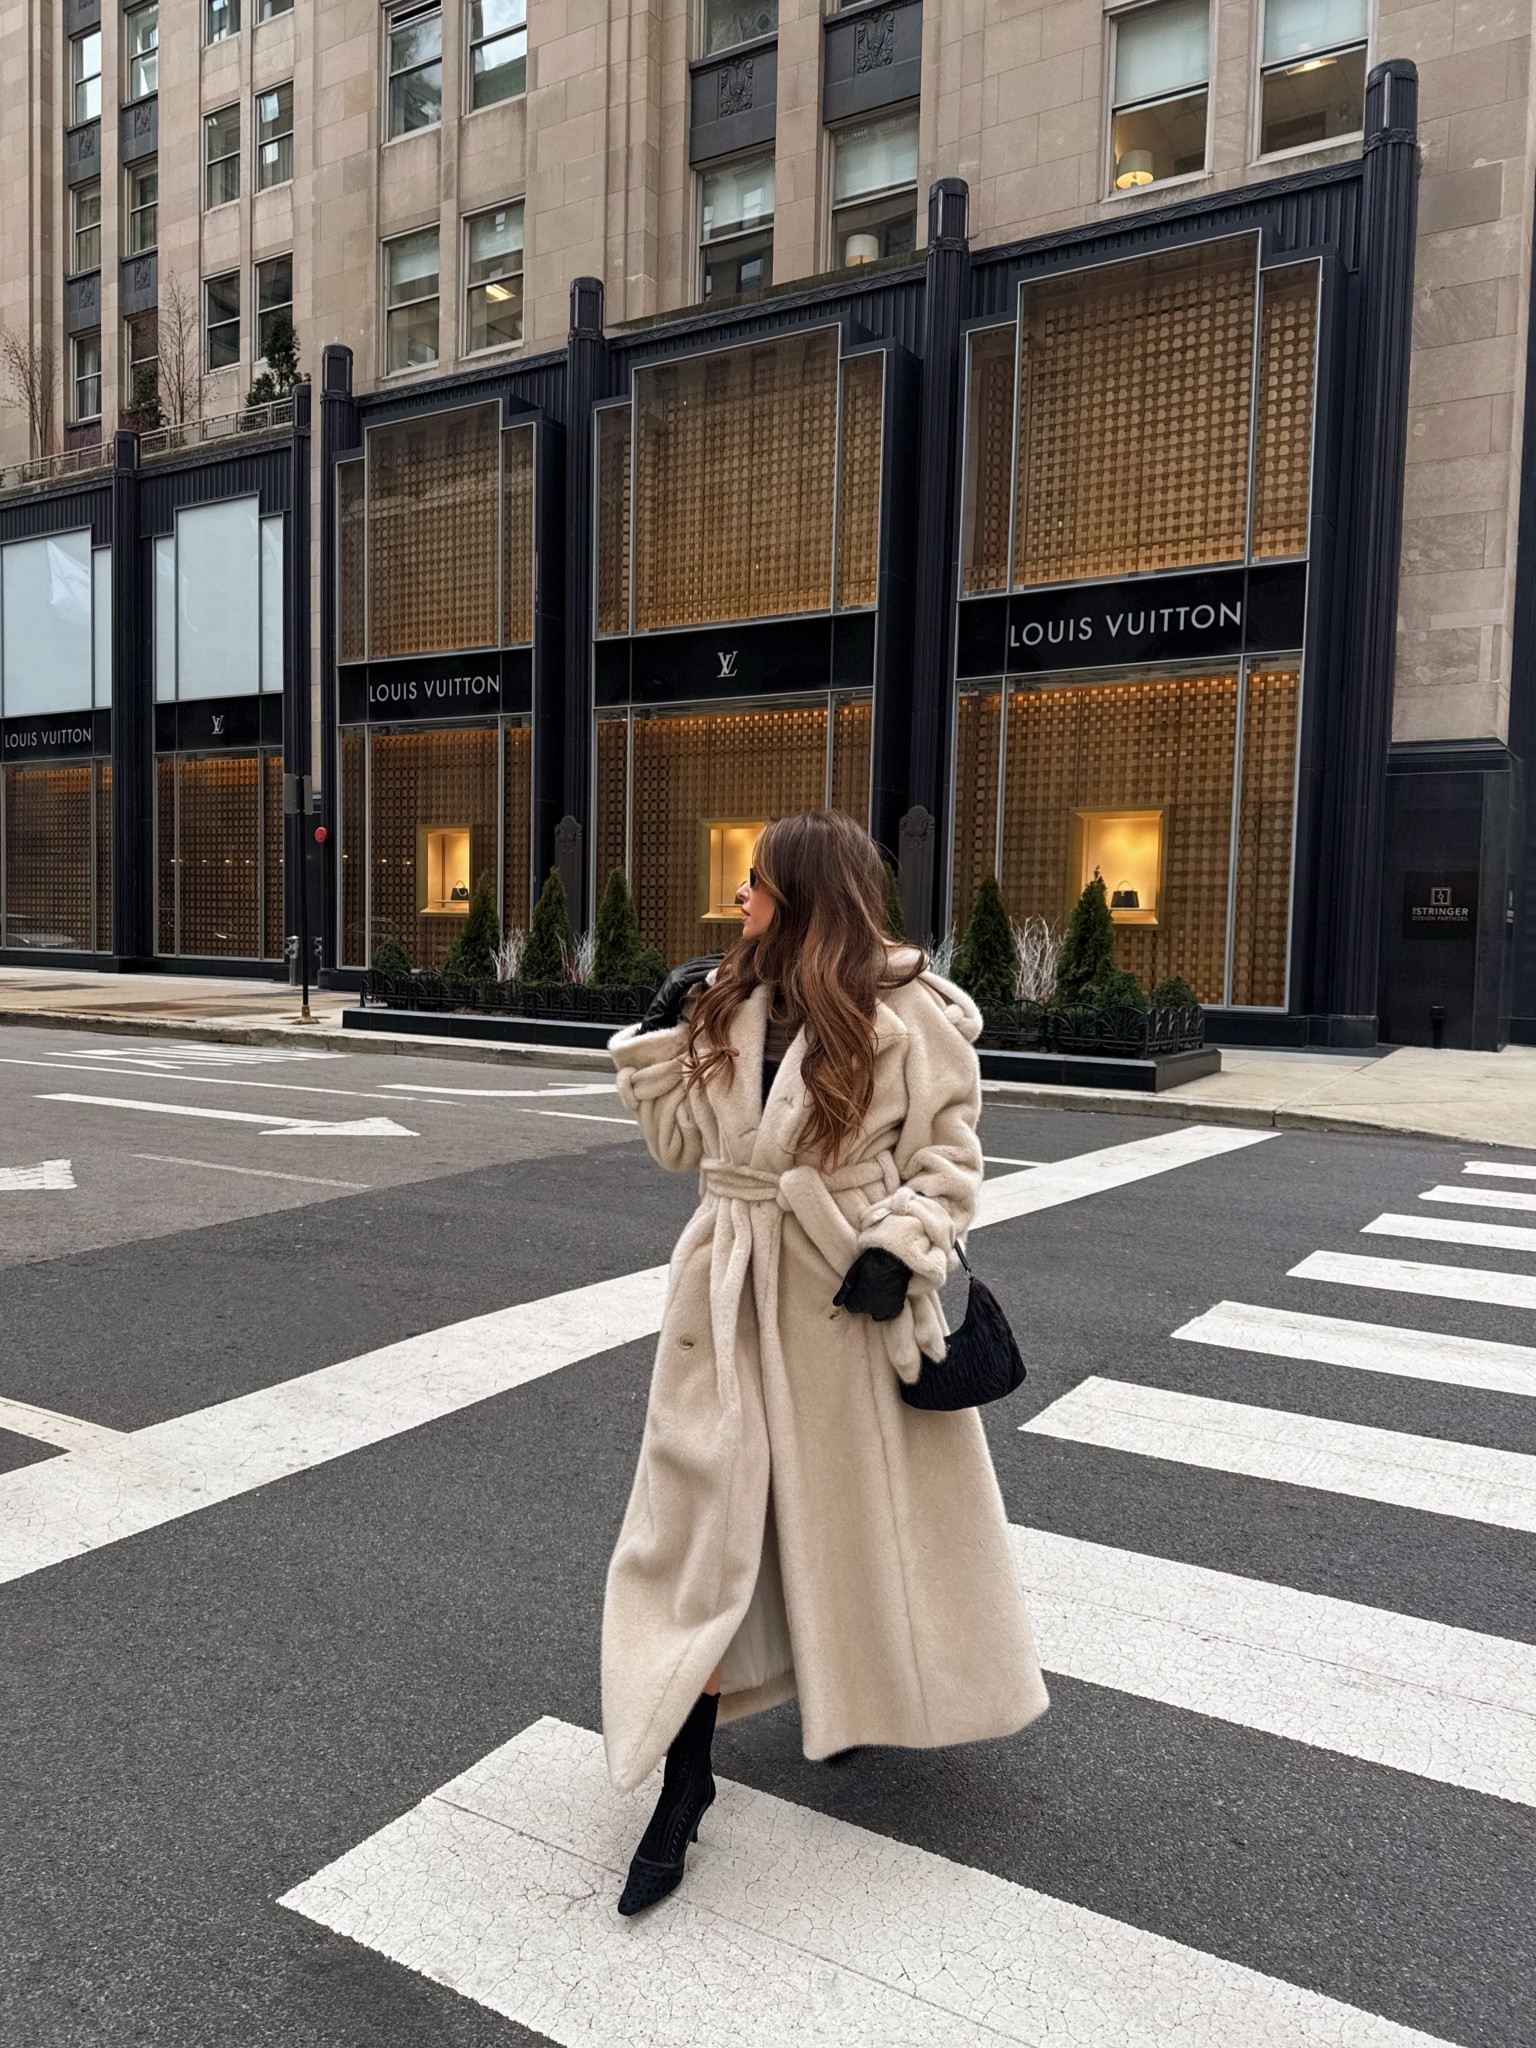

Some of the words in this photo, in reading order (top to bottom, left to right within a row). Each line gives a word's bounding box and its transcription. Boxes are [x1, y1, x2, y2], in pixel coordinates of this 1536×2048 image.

[1010, 616, 1093, 648] LOUIS
[1105, 601, 1242, 638] VUITTON
[369, 681, 417, 702] LOUIS
[423, 674, 500, 698] VUITTON
[4, 731, 38, 748] LOUIS
[41, 727, 92, 745] VUITTON
